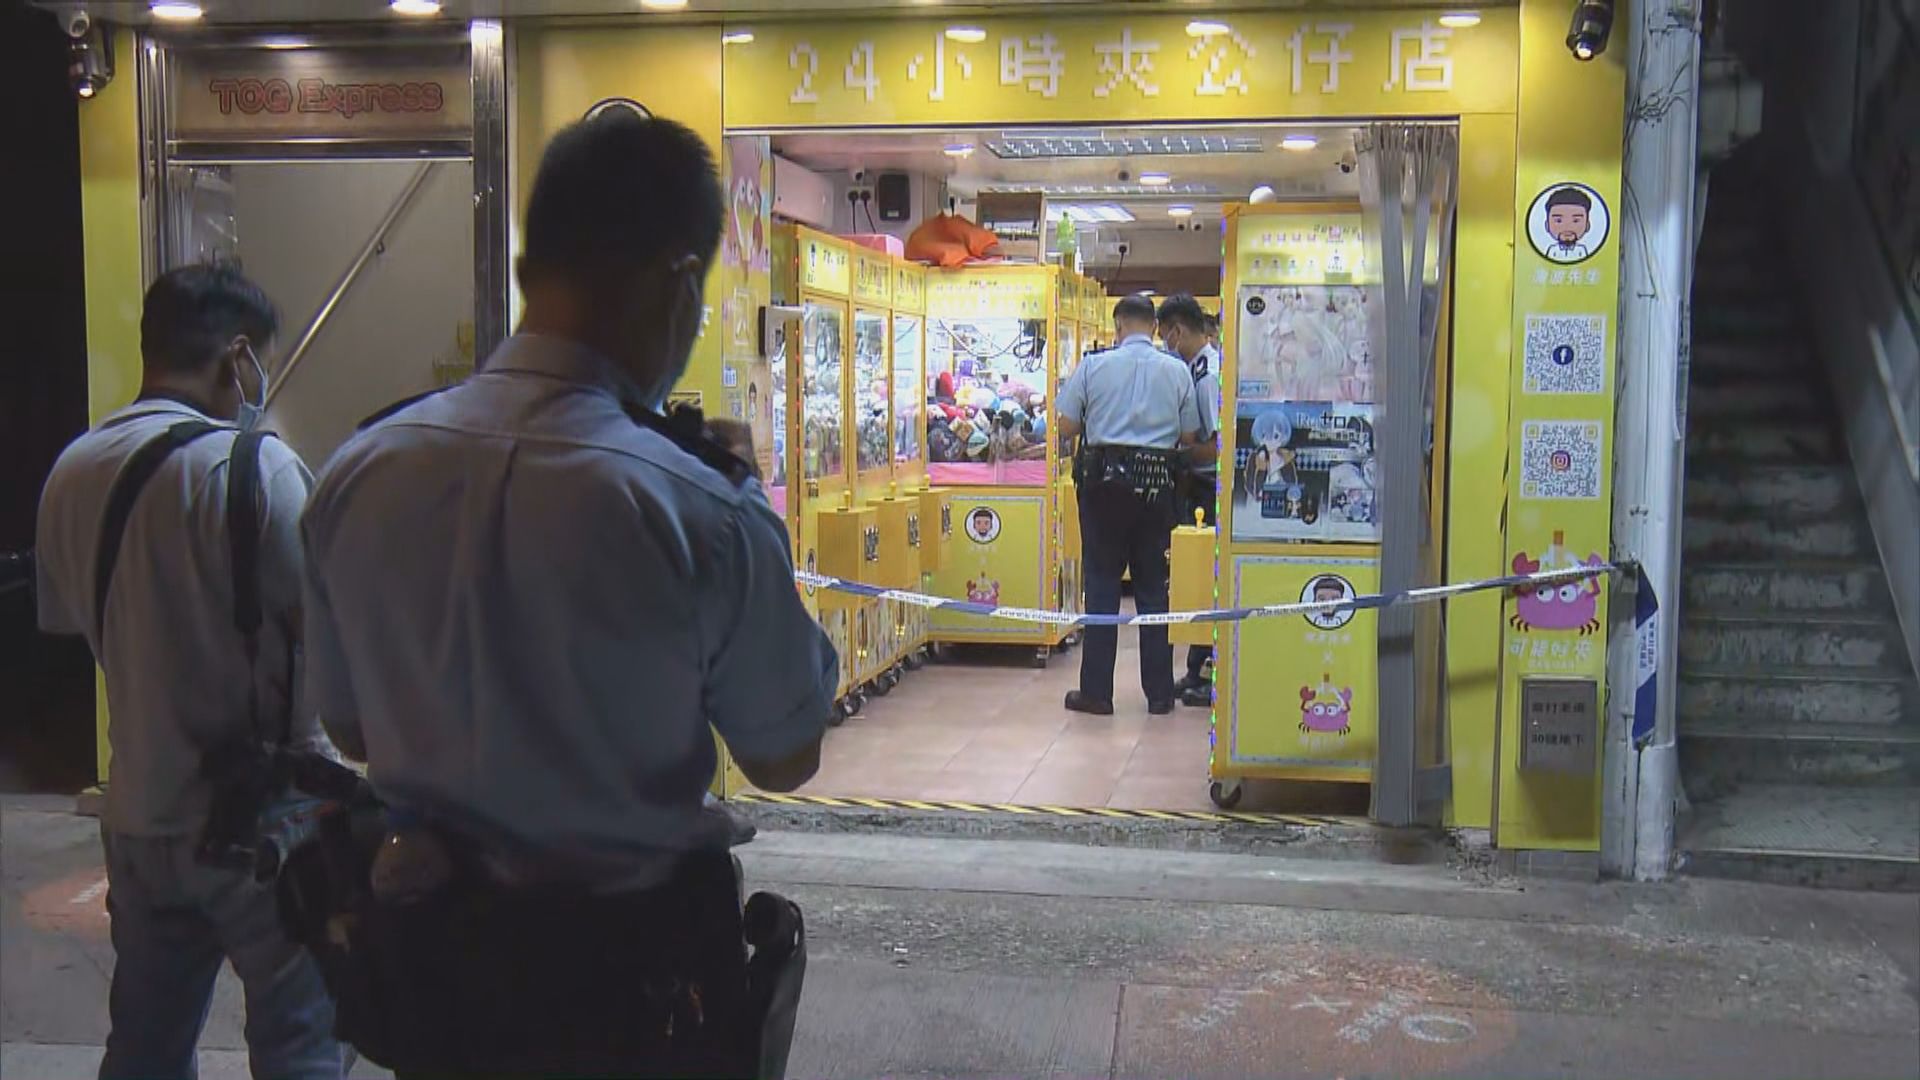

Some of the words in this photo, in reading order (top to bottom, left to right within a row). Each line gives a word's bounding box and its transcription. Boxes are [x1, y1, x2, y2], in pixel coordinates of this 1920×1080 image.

[788, 20, 1454, 103] 24小時夾公仔店
[297, 78, 443, 119] Express
